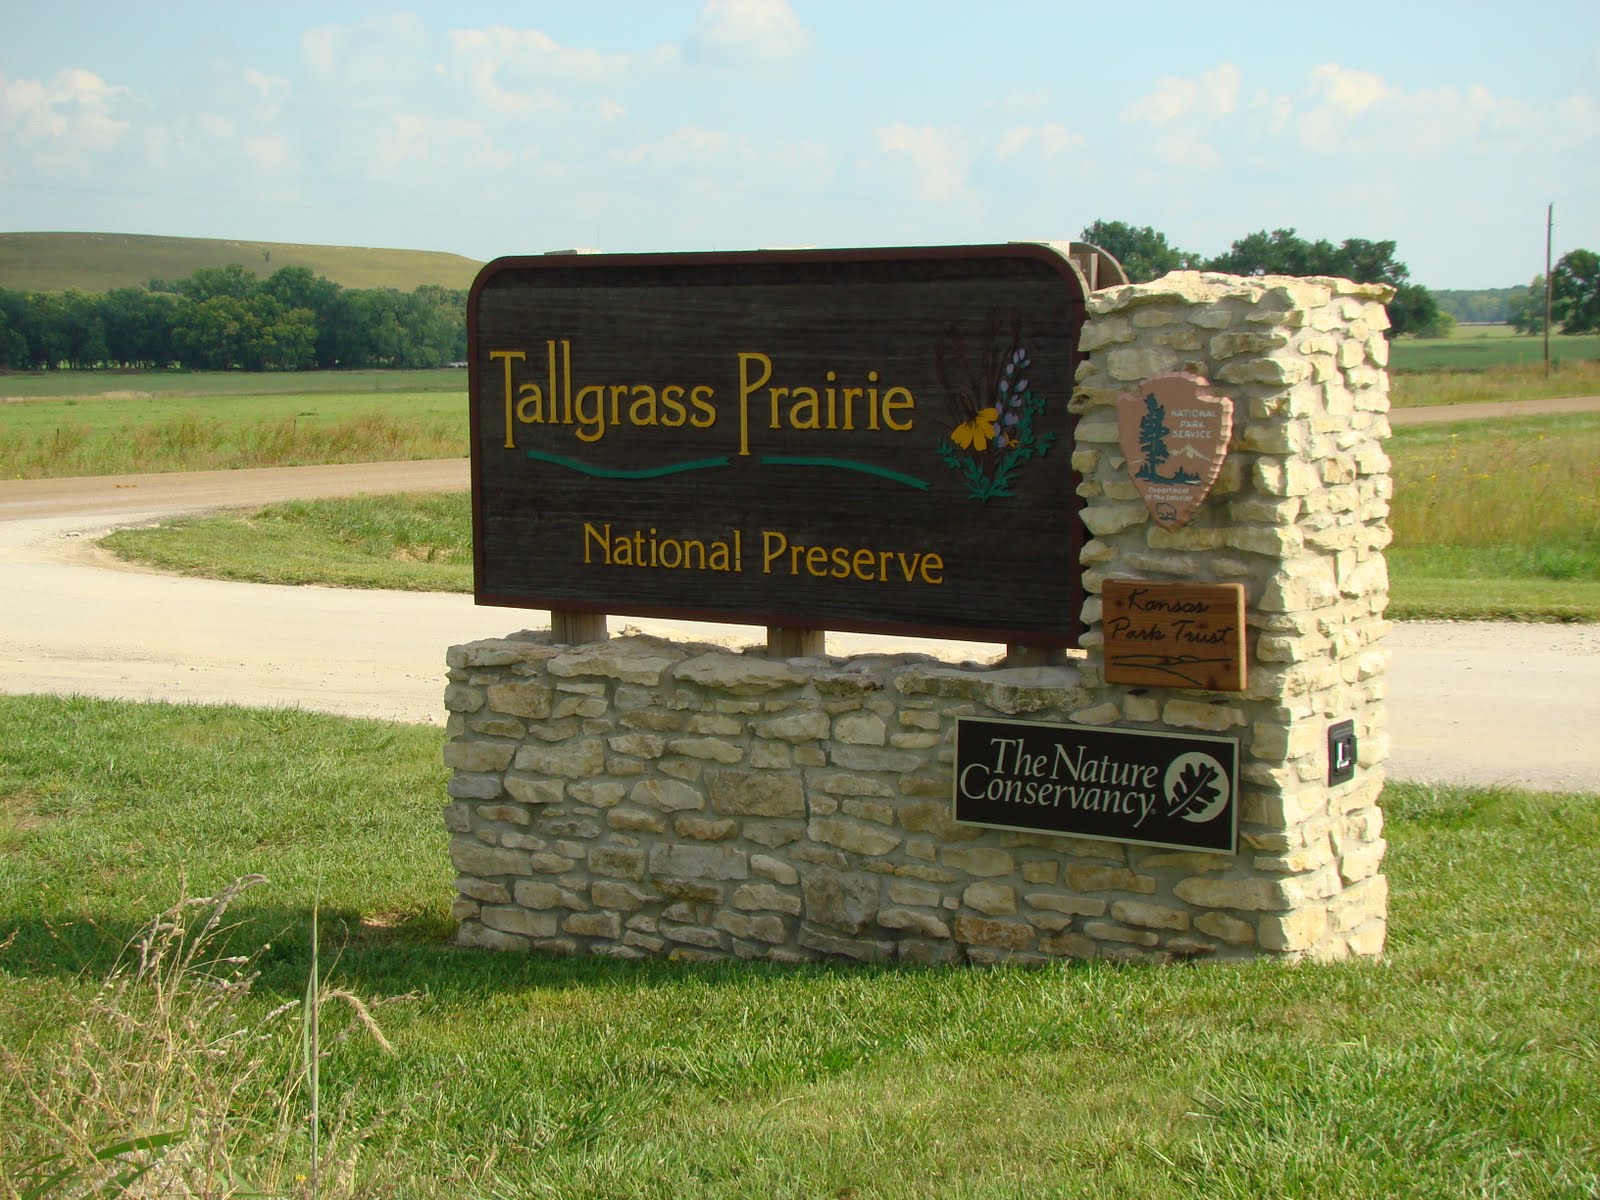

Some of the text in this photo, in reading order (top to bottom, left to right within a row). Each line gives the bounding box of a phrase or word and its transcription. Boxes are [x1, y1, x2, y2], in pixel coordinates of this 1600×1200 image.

[490, 340, 915, 456] Tallgrass Prairie
[1171, 409, 1217, 418] NATIONAL
[1180, 420, 1205, 428] PARK
[1171, 430, 1212, 439] SERVICE
[583, 523, 945, 584] National Preserve
[1128, 589, 1210, 614] Kansas
[1108, 617, 1234, 643] Park Trust
[990, 738, 1158, 788] The Nature
[960, 763, 1155, 828] Conservancy
